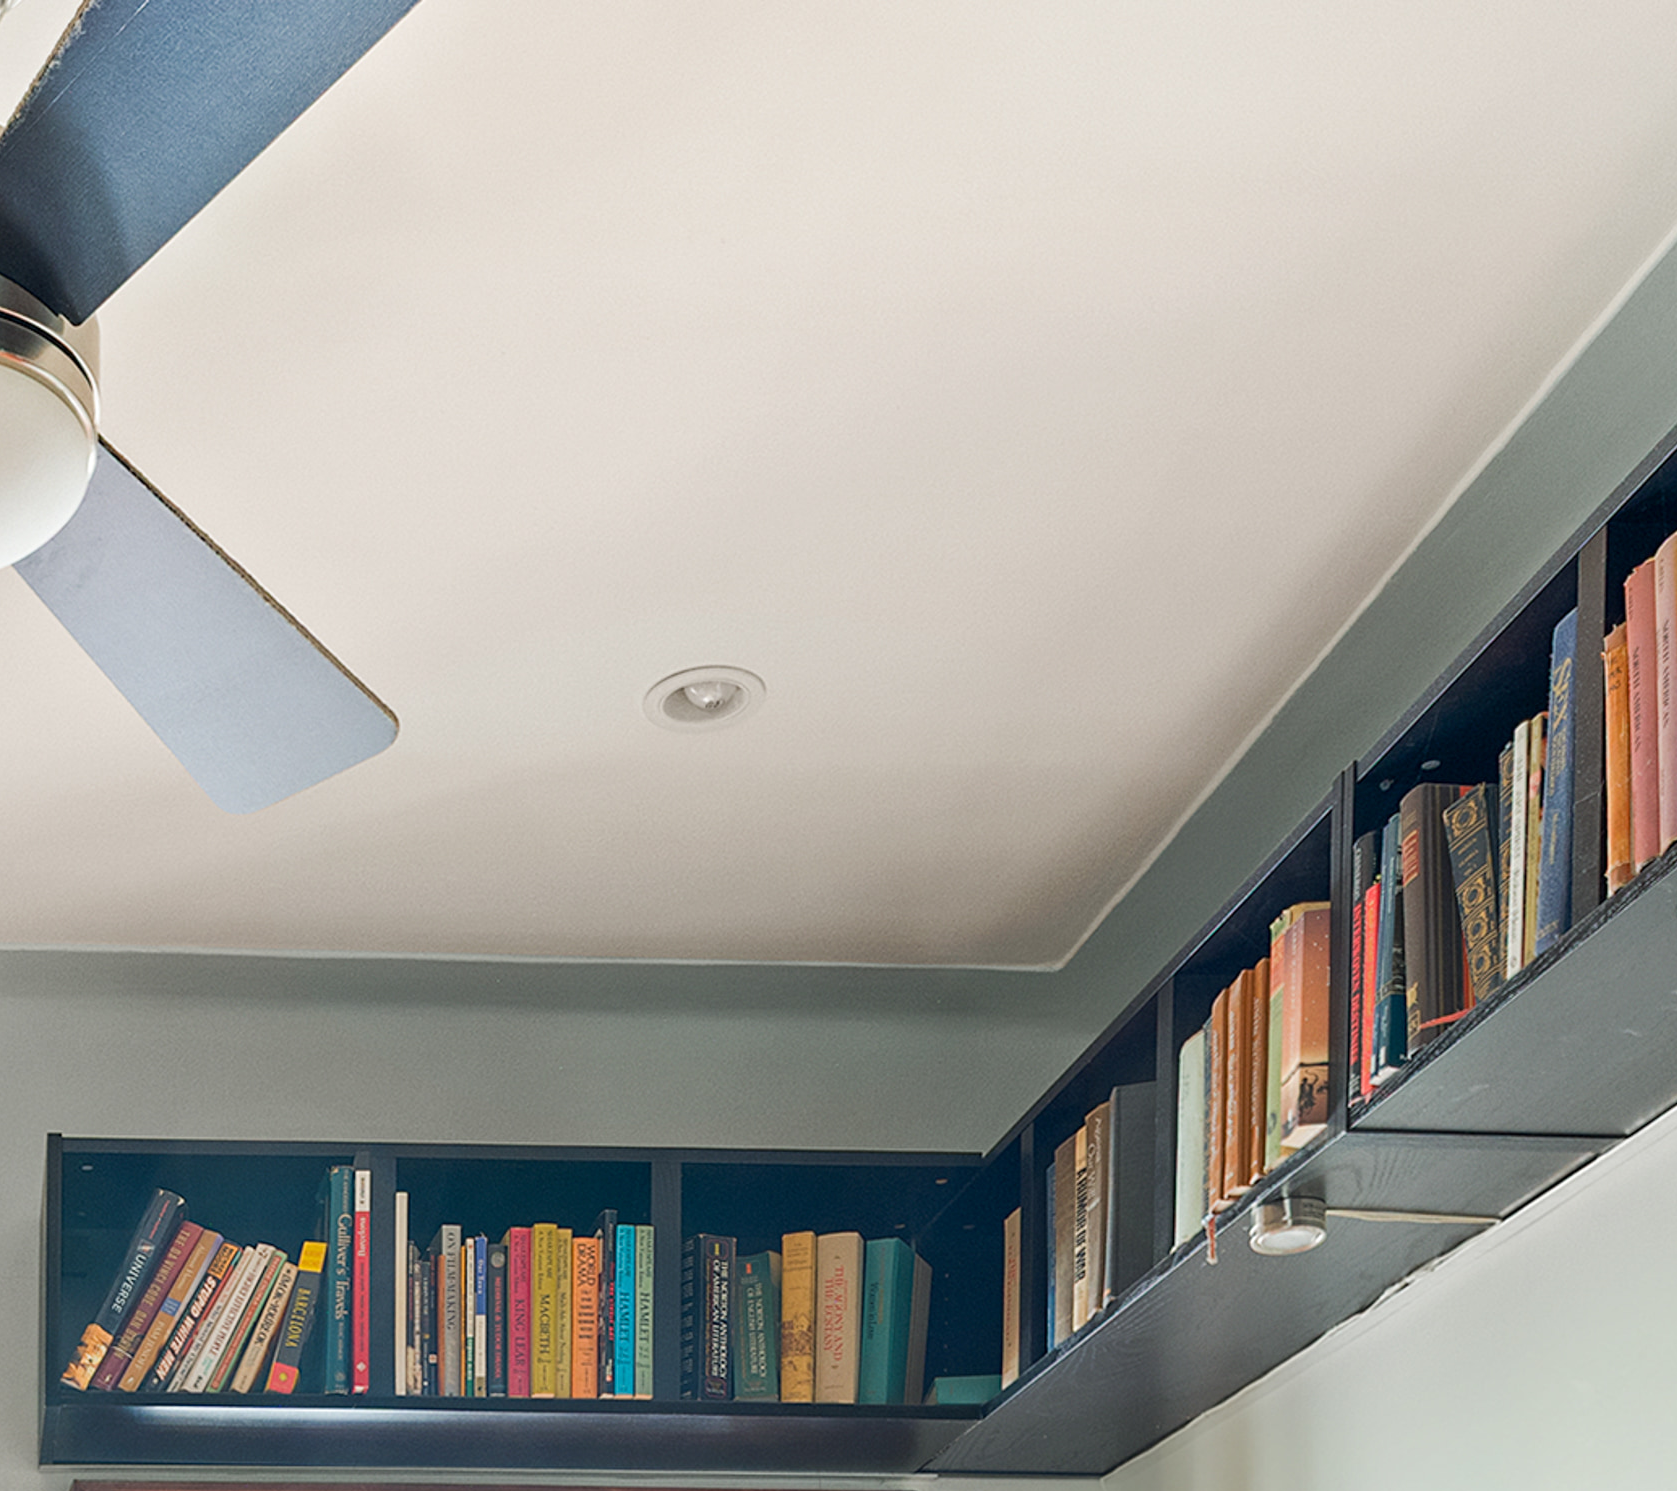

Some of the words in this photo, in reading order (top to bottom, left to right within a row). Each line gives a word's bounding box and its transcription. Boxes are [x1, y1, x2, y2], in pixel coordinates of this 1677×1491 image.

[1661, 619, 1671, 668] NORTH
[1631, 645, 1641, 691] NORTH
[1633, 692, 1643, 753] AMERICAN
[1661, 669, 1671, 730] AMERICAN
[1076, 1177, 1088, 1231] RUMOR
[335, 1213, 354, 1278] Gulliver's
[446, 1231, 457, 1248] ON
[1075, 1231, 1087, 1248] OF
[112, 1254, 148, 1316] UNIVERSE
[577, 1242, 587, 1288] DRAMA
[586, 1243, 596, 1288] WORLD
[720, 1260, 728, 1279] THE
[825, 1277, 834, 1299] THE
[834, 1265, 844, 1289] THE
[1074, 1249, 1087, 1284] WAR
[192, 1275, 217, 1320] STUPID
[333, 1276, 351, 1321] Travels
[446, 1252, 457, 1331] FILM-MAKING
[712, 1272, 720, 1323] AMERICAN
[719, 1281, 728, 1321] NORTON
[833, 1292, 844, 1334] AGONY
[170, 1314, 195, 1352] WHITE
[284, 1287, 313, 1349] BARCELONA
[514, 1298, 526, 1332] KING
[539, 1293, 551, 1355] MACBETH
[618, 1291, 630, 1343] HAMLET
[639, 1291, 651, 1343] HAMLET
[824, 1306, 834, 1352] ECSTASY
[155, 1350, 175, 1381] MEN
[514, 1336, 526, 1366] LEAR
[711, 1324, 720, 1377] LITERATURE
[719, 1322, 729, 1379] ANTHOLOGY
[832, 1335, 843, 1362] AND
